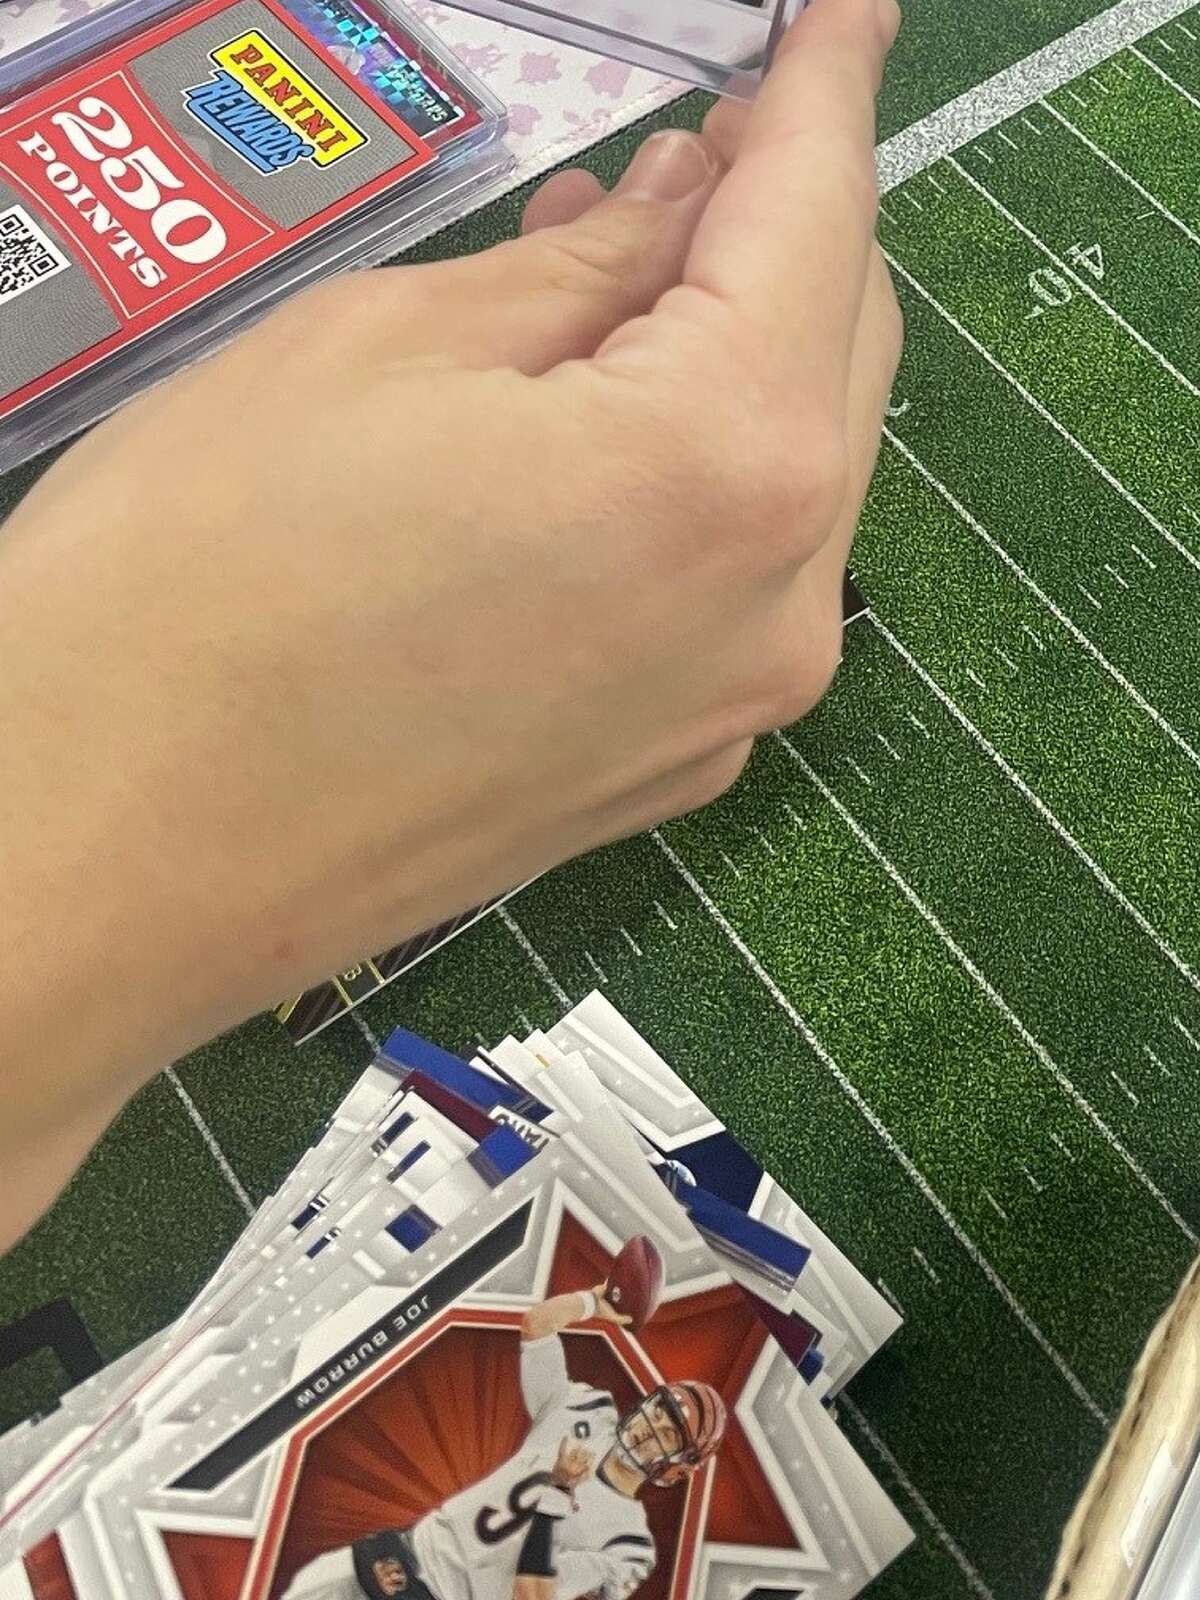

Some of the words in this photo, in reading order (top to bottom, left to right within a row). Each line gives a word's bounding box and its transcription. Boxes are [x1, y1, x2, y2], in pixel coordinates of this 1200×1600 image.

[185, 70, 316, 168] REWARDS
[230, 44, 348, 153] PANINI
[18, 131, 167, 289] POINTS
[53, 97, 229, 265] 250
[1028, 240, 1108, 310] 40
[392, 1295, 429, 1331] JOE
[297, 1330, 389, 1409] BURROW
